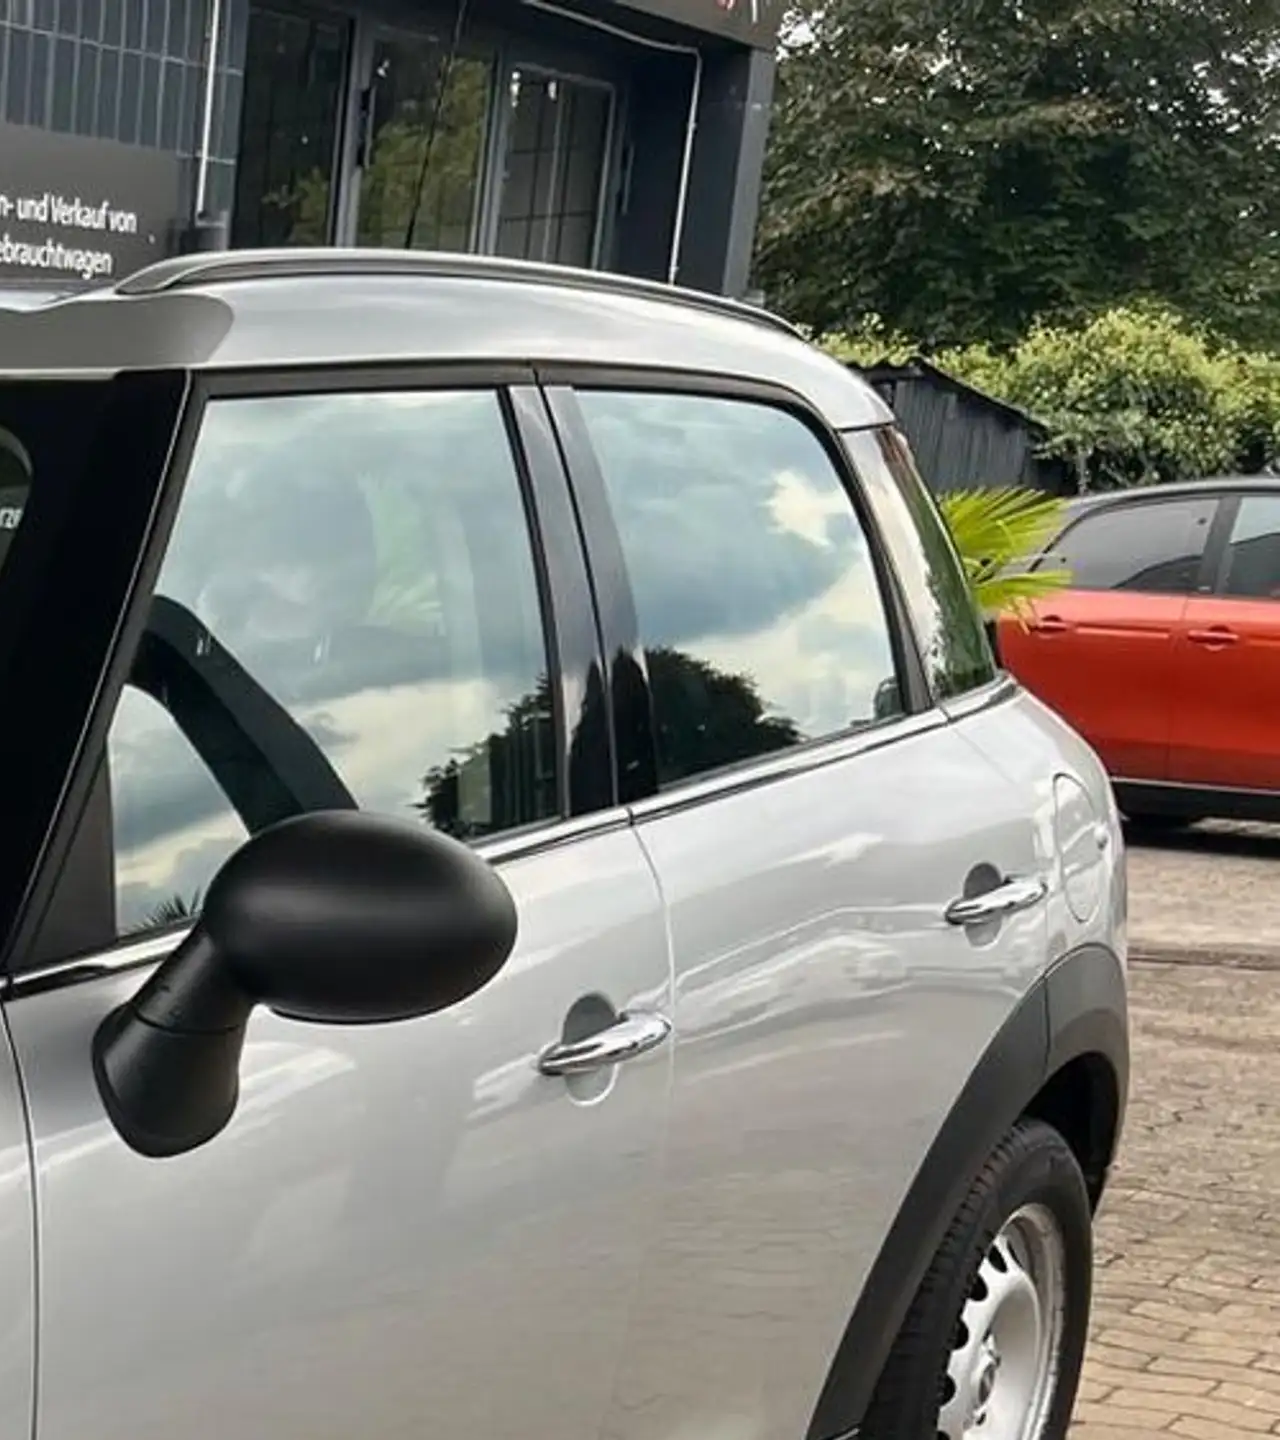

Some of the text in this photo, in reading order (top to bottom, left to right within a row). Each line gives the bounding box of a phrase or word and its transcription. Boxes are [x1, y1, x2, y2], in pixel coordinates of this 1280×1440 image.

[17, 192, 48, 223] und
[50, 195, 109, 230] Verkauf
[109, 210, 138, 233] von
